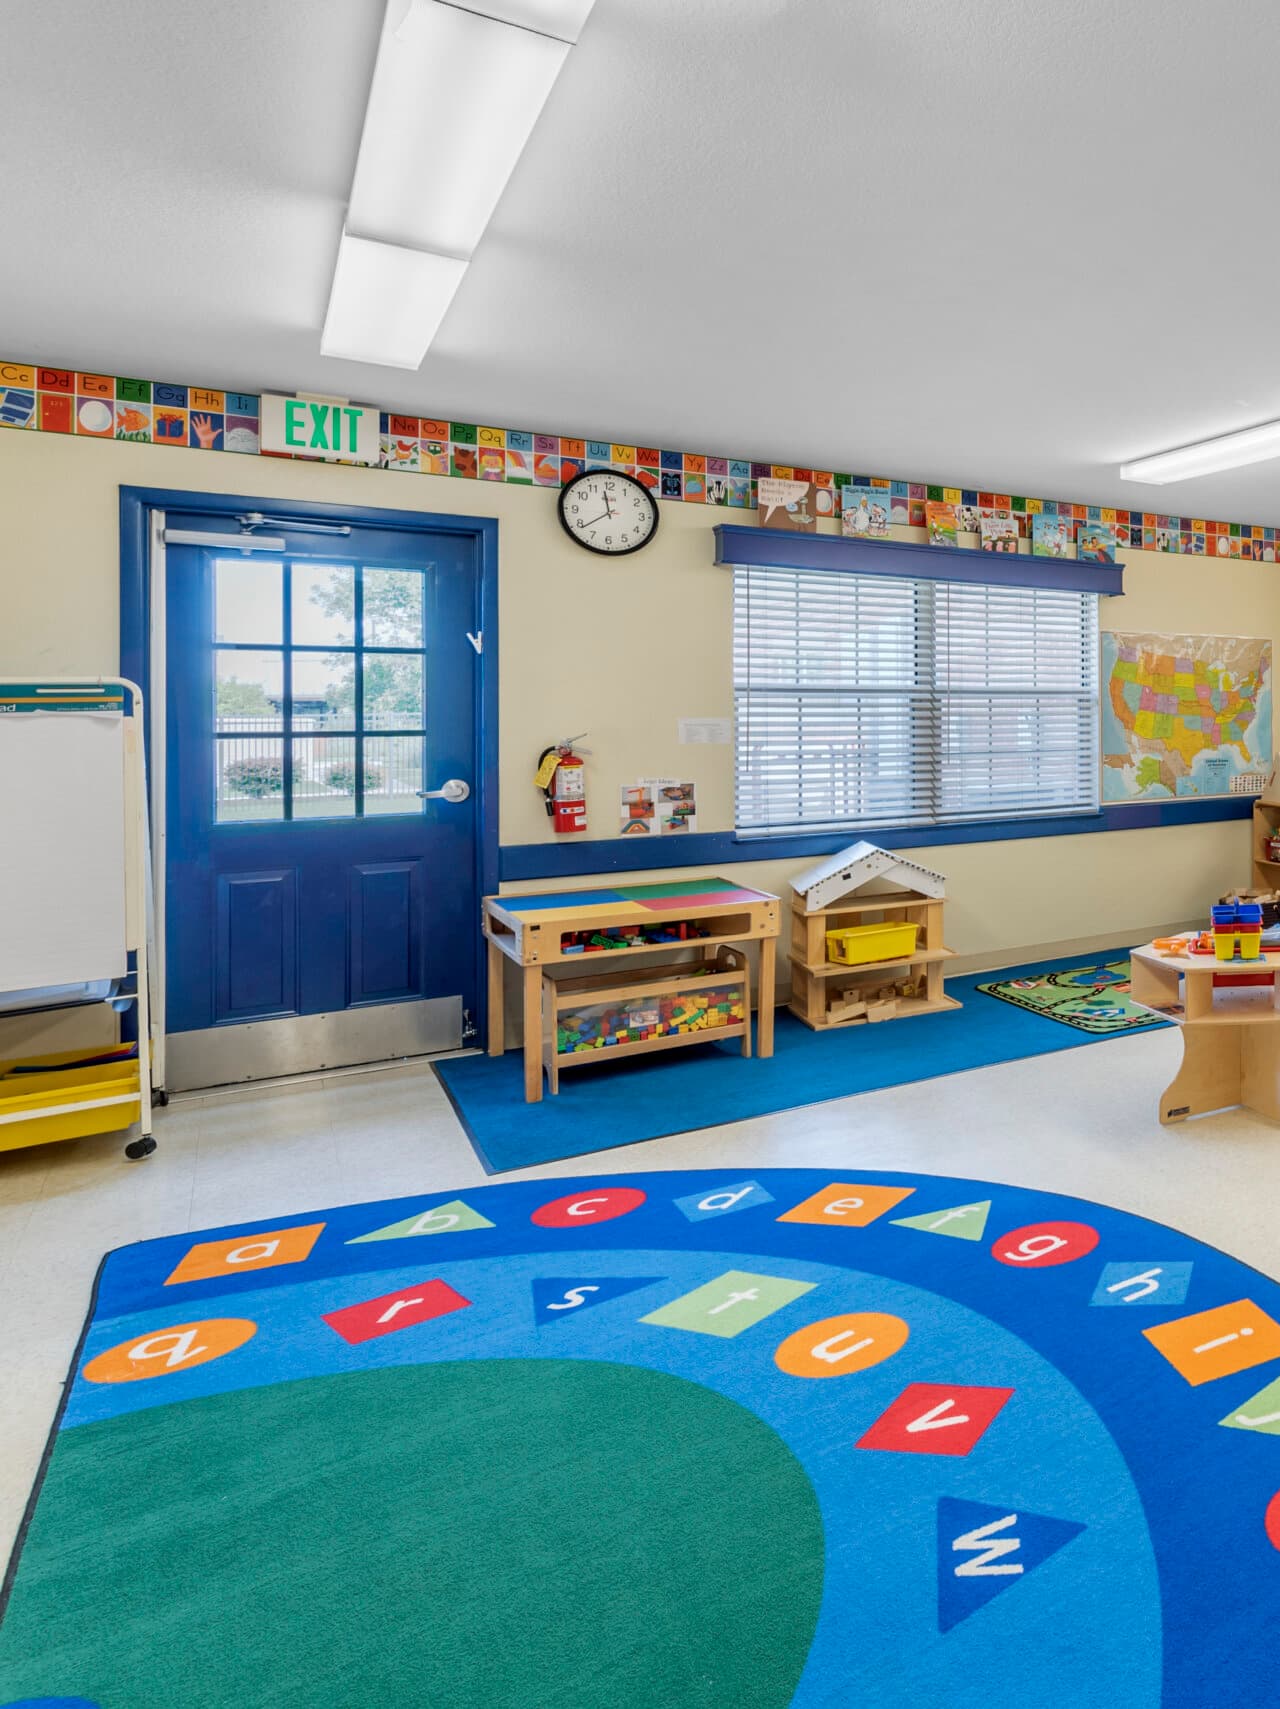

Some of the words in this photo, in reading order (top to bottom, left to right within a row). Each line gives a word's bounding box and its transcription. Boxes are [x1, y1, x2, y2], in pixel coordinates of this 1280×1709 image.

[1, 366, 29, 382] Cc
[41, 371, 69, 387] Dd
[83, 376, 108, 392] Ee
[121, 381, 145, 396] Ff
[156, 386, 185, 405] Gg
[194, 391, 219, 406] Hh
[237, 396, 248, 410] Ii
[285, 399, 363, 453] EXIT
[393, 417, 415, 431] Nn
[423, 421, 445, 435] Oo
[453, 425, 473, 443] Pp
[480, 429, 504, 448] Qq
[510, 433, 529, 446] Rr
[537, 437, 554, 449] Ss
[567, 440, 581, 453] Tt
[590, 443, 608, 457] Uu
[616, 447, 631, 459] Vv
[637, 450, 658, 462] Ww
[687, 456, 703, 472] Yy
[731, 463, 749, 474] Aa
[588, 484, 598, 493] 11
[604, 481, 615, 491] 12
[577, 491, 588, 501] 10
[622, 488, 627, 497] 1
[633, 498, 640, 507] 2
[571, 505, 579, 514] 9
[638, 512, 645, 521] 3
[576, 519, 584, 528] 8
[589, 530, 597, 539] 7
[621, 533, 628, 542] 5
[605, 535, 612, 544] 6
[225, 1239, 281, 1265] a
[408, 1207, 461, 1238] b
[566, 1193, 609, 1216] c
[697, 1186, 755, 1211] d
[824, 1195, 865, 1216] e
[929, 1204, 980, 1230] f
[1005, 1235, 1069, 1262] g
[1107, 1268, 1163, 1303] h
[1194, 1328, 1255, 1354] i
[128, 1329, 207, 1369] q
[377, 1297, 425, 1325] r
[547, 1286, 600, 1312] s
[708, 1284, 760, 1316] t
[811, 1330, 875, 1364] u
[906, 1399, 970, 1435] v
[953, 1515, 1025, 1578] w
